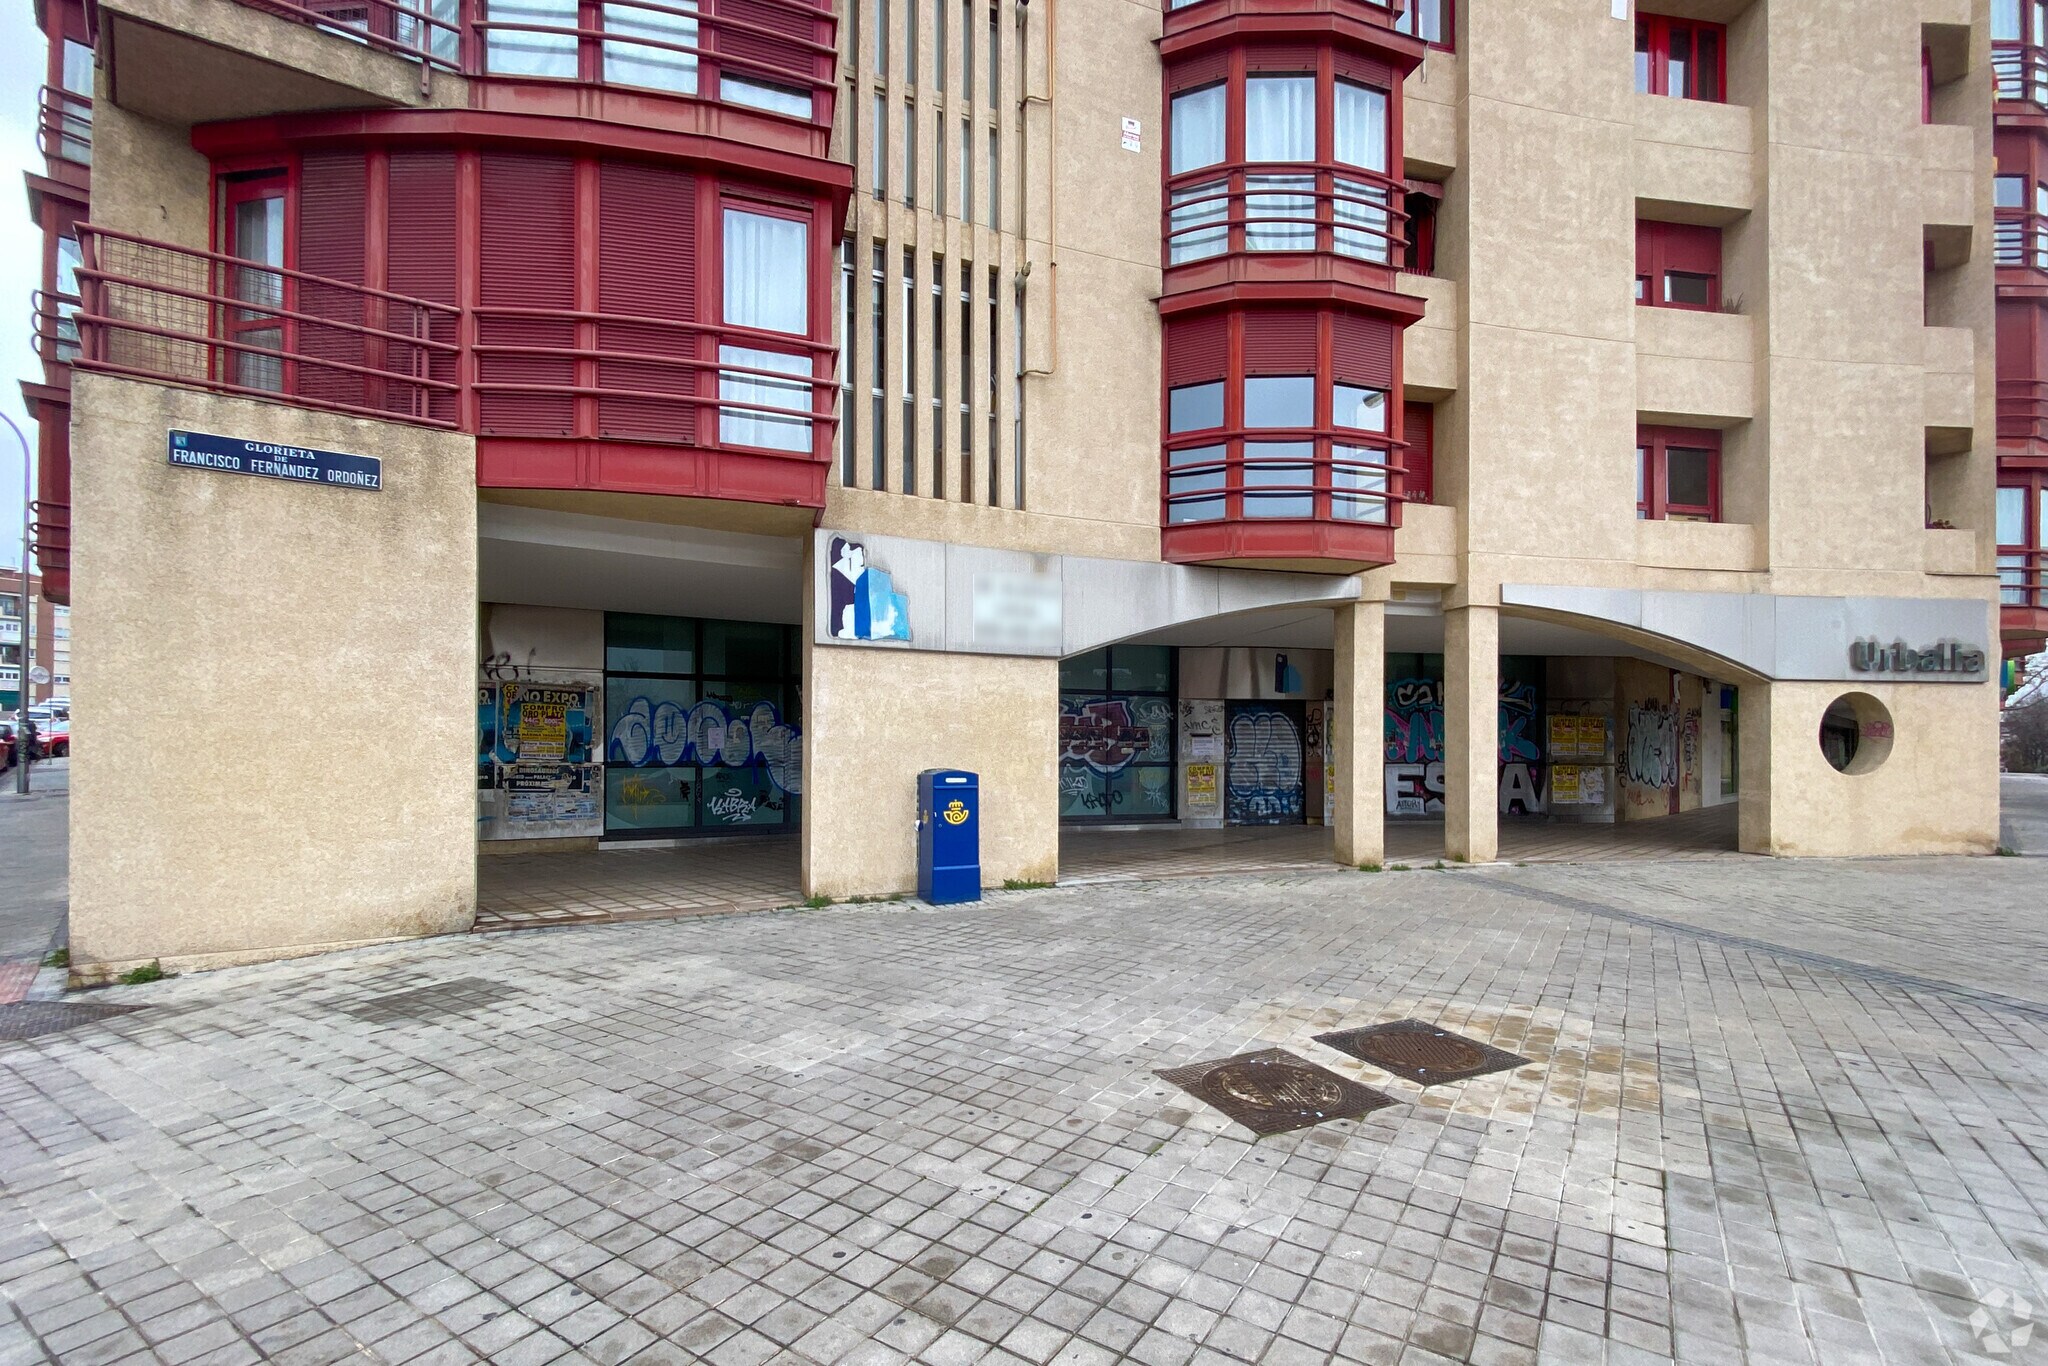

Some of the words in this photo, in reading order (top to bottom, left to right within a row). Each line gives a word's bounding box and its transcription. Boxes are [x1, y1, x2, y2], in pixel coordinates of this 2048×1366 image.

[244, 442, 316, 460] GLORIETA
[274, 455, 288, 463] DE
[173, 448, 240, 470] FRANCISCO
[326, 468, 379, 488] ORDOÑEZ
[543, 690, 579, 704] EXPO
[522, 704, 565, 712] COMPRO
[522, 710, 539, 718] ORO
[541, 710, 565, 719] PLATA
